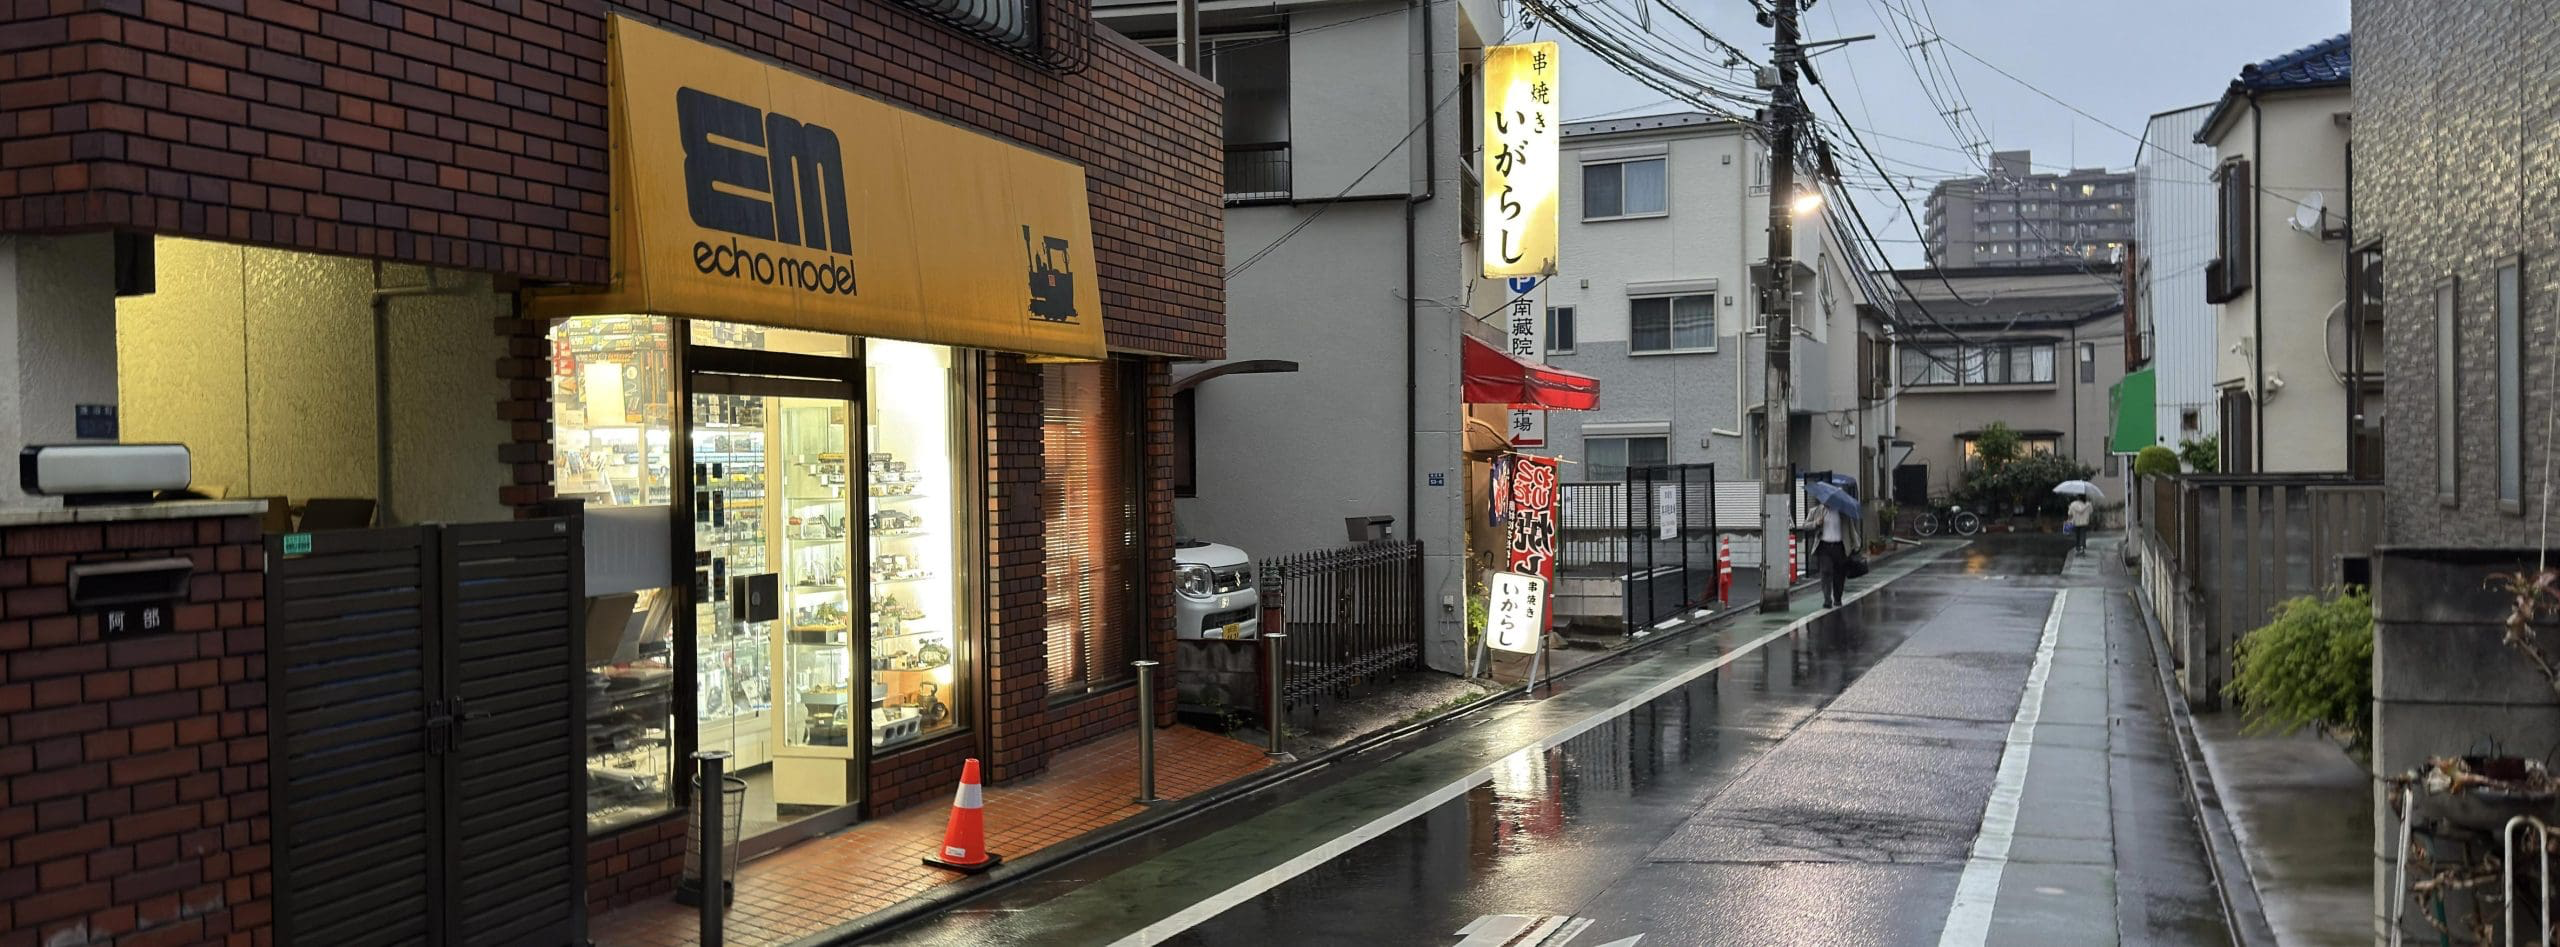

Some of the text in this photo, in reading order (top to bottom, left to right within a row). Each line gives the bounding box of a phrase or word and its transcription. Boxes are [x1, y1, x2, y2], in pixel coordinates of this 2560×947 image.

[1531, 50, 1549, 134] 串焼き
[676, 86, 853, 256] EM
[1494, 110, 1528, 265] いがらし
[693, 237, 857, 296] echo model
[108, 607, 160, 633] 阿部
[1526, 582, 1537, 618] 串焼き
